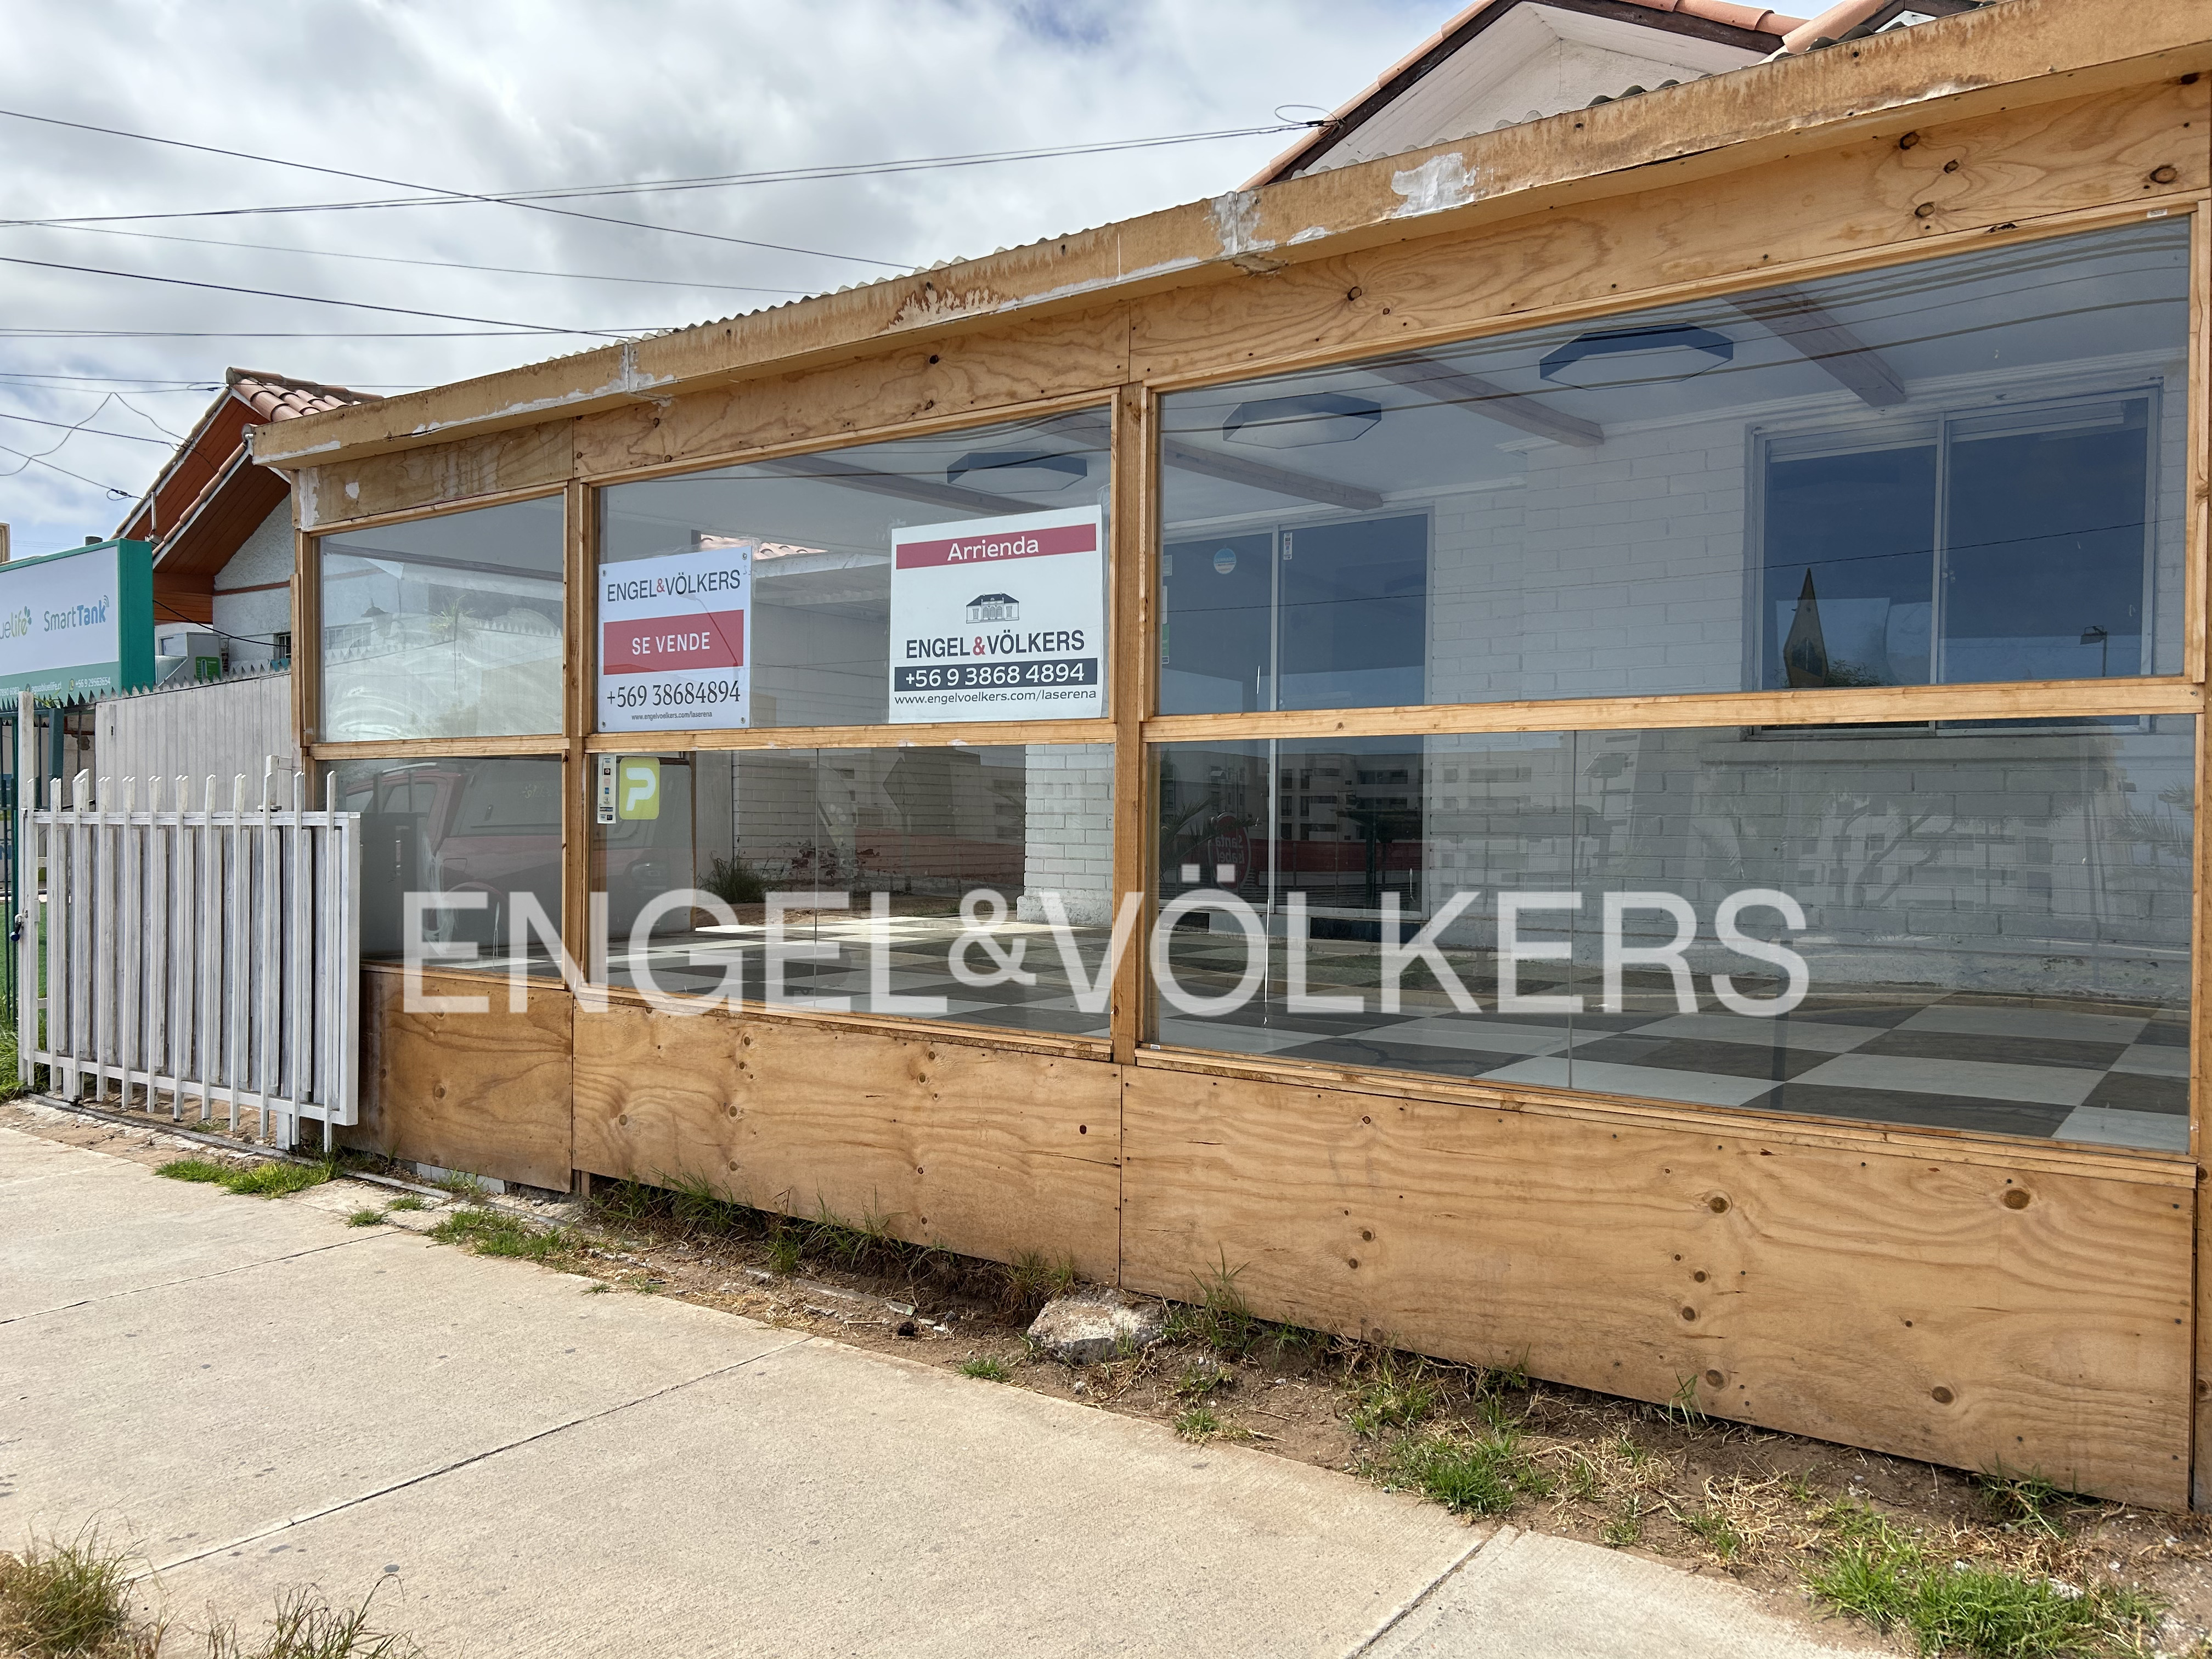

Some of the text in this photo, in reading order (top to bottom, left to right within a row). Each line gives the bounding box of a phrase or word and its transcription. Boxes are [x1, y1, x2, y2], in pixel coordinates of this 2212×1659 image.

[947, 535, 1039, 561] Arrienda
[607, 569, 741, 602] ENGEL&VÖLKERS
[632, 632, 710, 656] SE VENDE
[906, 629, 1085, 659] ENGEL&VÖLKERS
[906, 663, 1085, 687] +56 9 3868 4894
[607, 680, 741, 708] +569 38684894
[894, 689, 1097, 704] www.engelvoelkers.com/laserena
[631, 711, 713, 721] www.engelvoelkers.com/laserena
